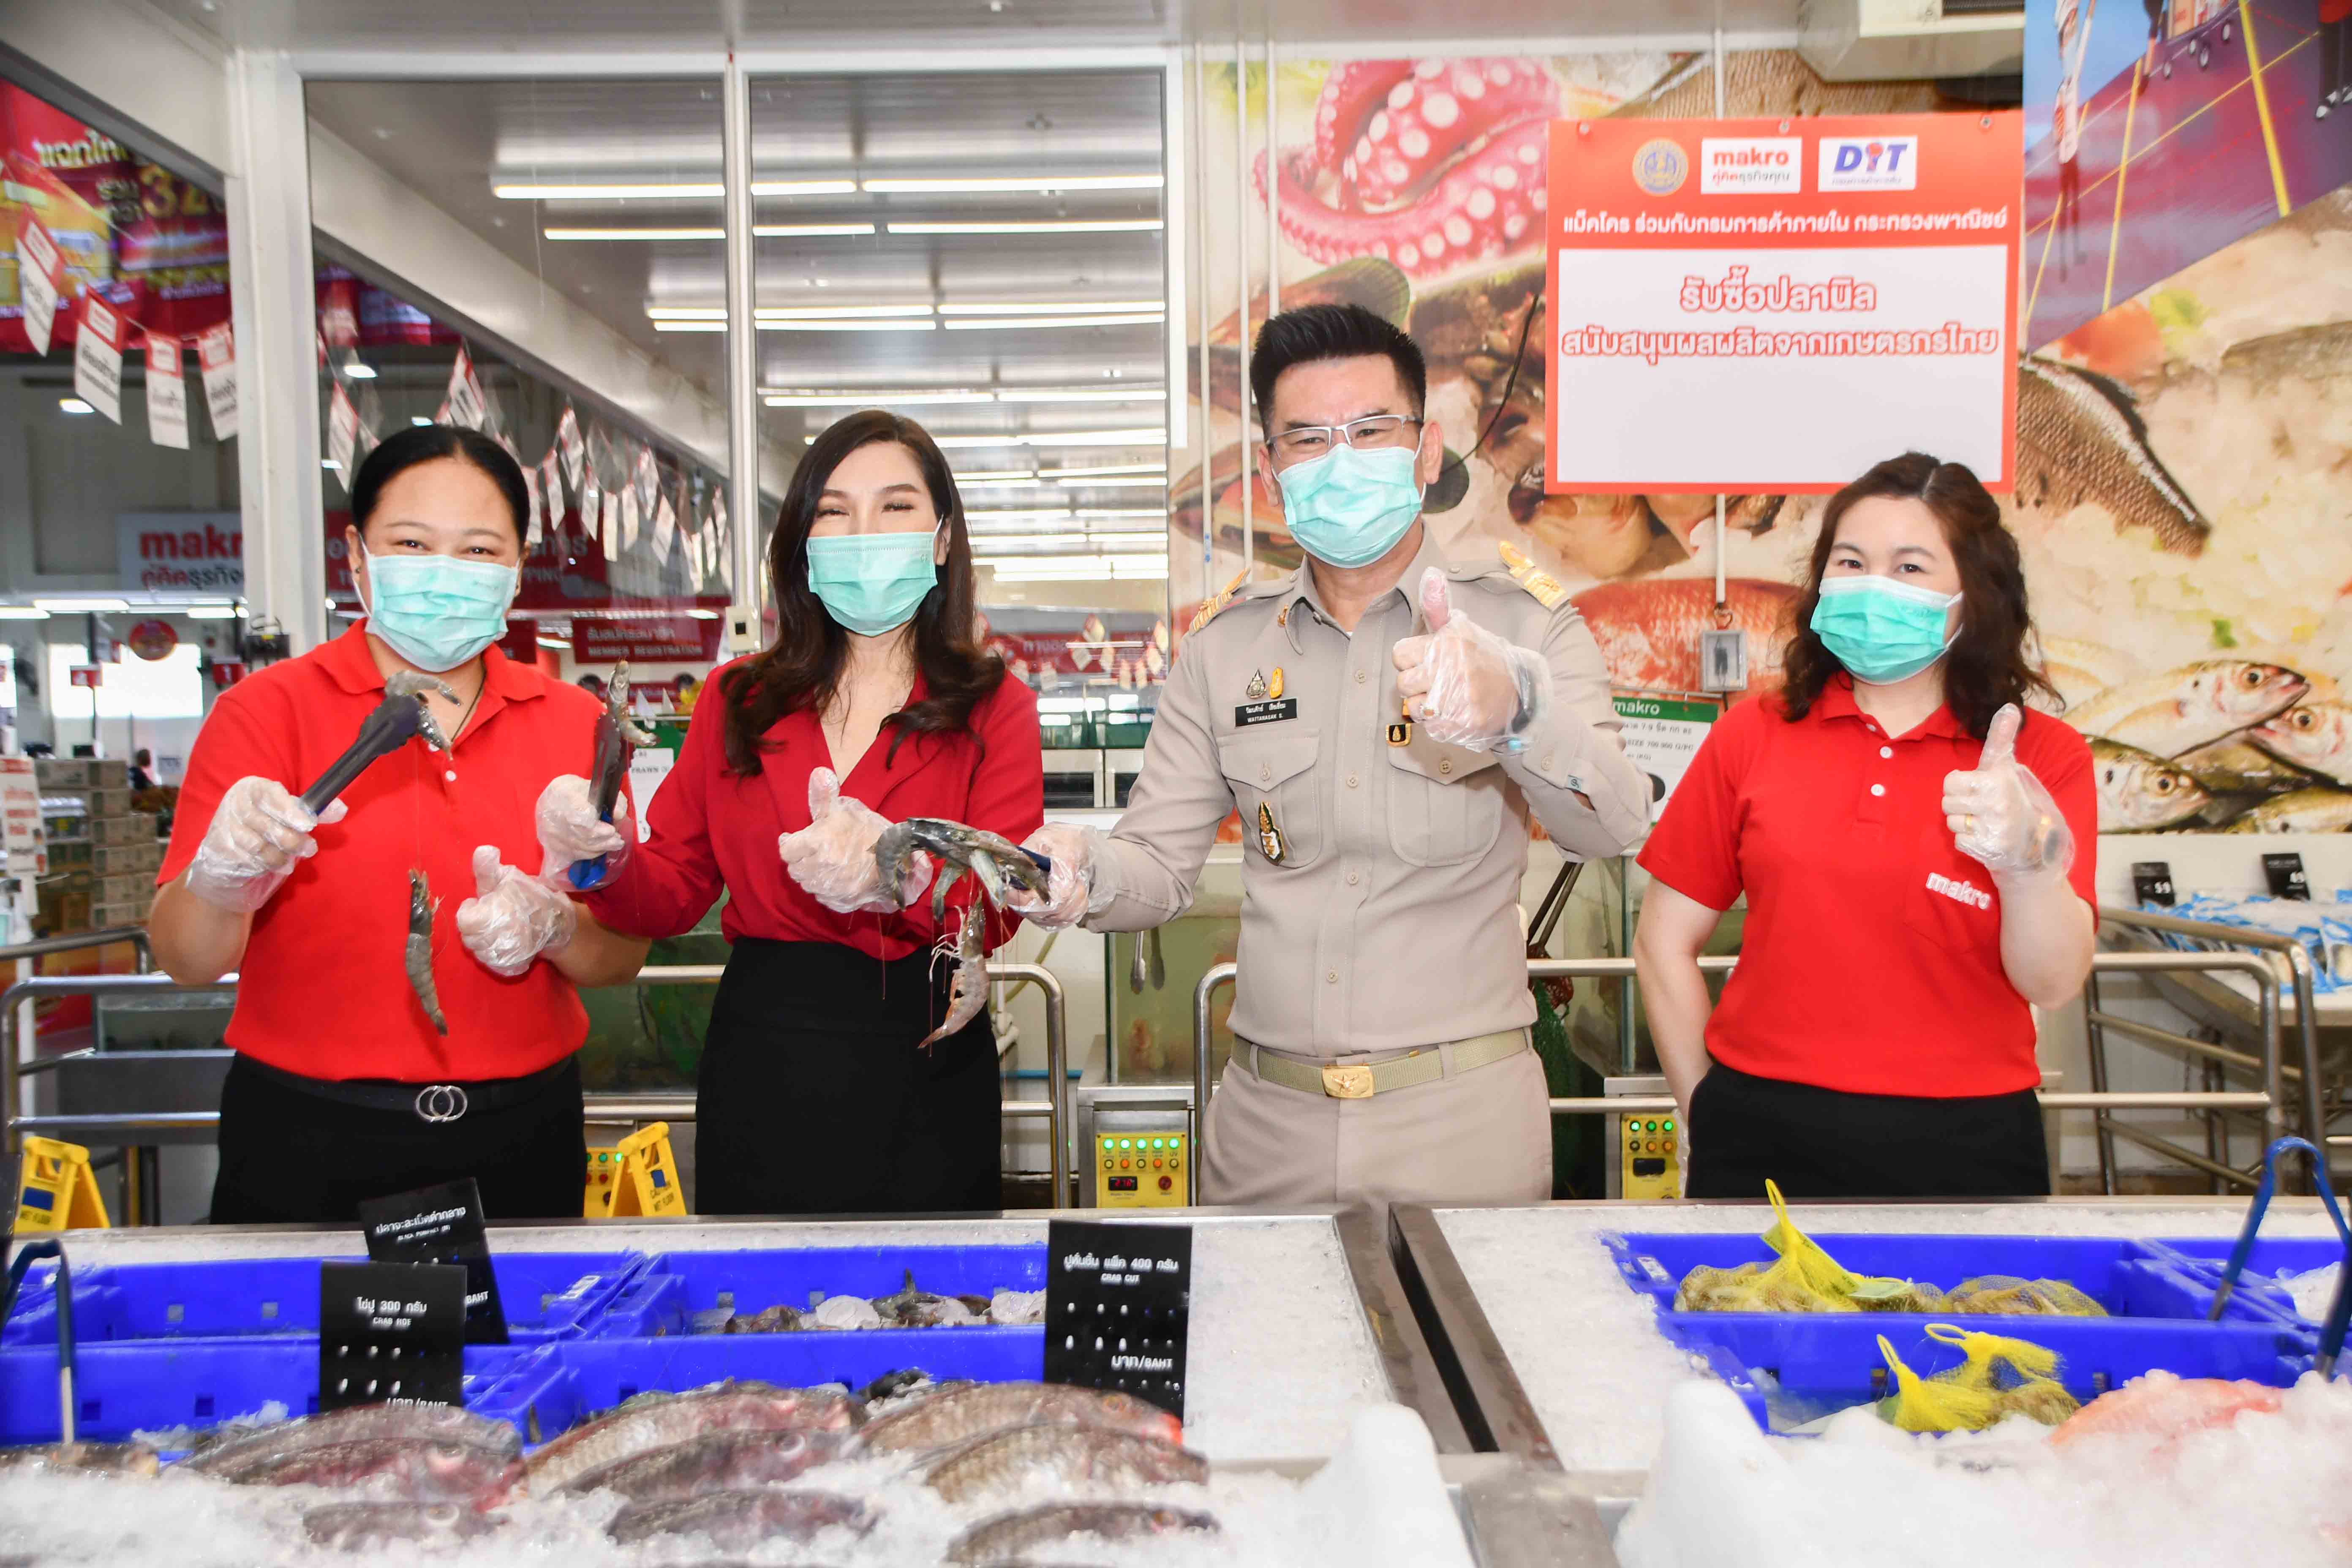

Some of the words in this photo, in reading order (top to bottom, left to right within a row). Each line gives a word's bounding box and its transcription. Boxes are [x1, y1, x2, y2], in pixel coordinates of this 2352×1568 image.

[1713, 147, 1789, 166] makro
[1564, 209, 1630, 233] แม็คโคร
[1635, 209, 1849, 234] ร่วมกับกรมการค้าภายใน
[1854, 206, 2008, 232] กระทรวงพาณิชย์
[1680, 265, 1877, 313] รับซื้อปลานิล
[1562, 321, 1998, 366] สนับสนุนผลผลิตจากเกษตรกรไทย
[140, 523, 243, 559] makr
[588, 645, 630, 656] MEMBER
[634, 645, 703, 656] REGISTRATION
[1613, 700, 1660, 715] makro
[1247, 713, 1277, 723] WATTANASAK
[1925, 871, 1991, 909] makro
[1130, 1258, 1152, 1270] 400
[1156, 1258, 1179, 1271] กรัม
[1124, 1274, 1140, 1283] CUT
[380, 1300, 401, 1311] 300
[406, 1301, 427, 1312] กรัม
[373, 1317, 393, 1326] CRAB
[1111, 1355, 1173, 1370] บาท/BAHT
